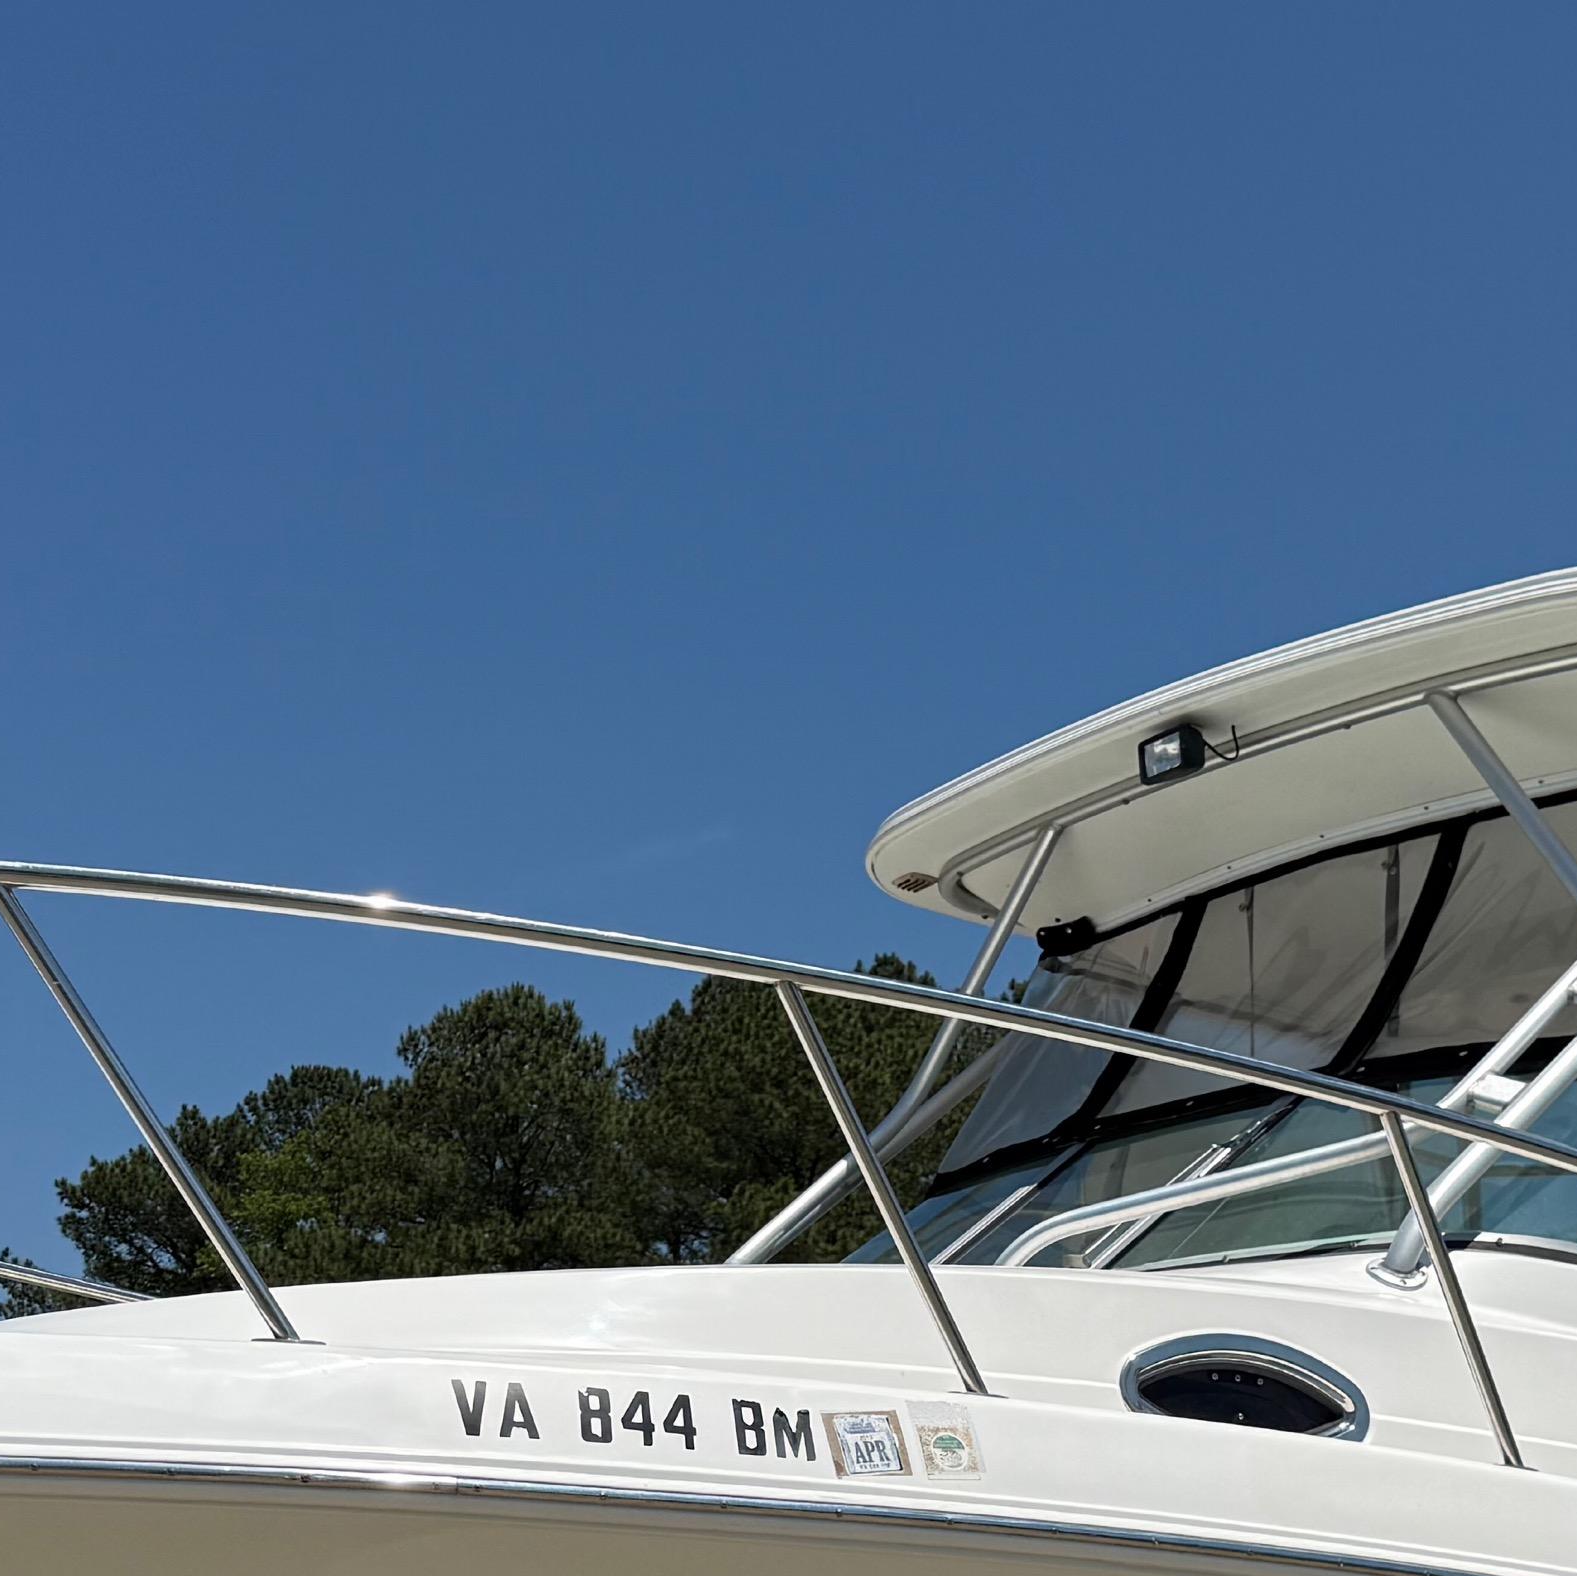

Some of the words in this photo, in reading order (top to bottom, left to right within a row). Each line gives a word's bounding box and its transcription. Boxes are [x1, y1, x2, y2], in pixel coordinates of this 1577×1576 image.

[450, 1378, 540, 1440] VA
[578, 1387, 697, 1451] 844
[731, 1398, 817, 1462] BM
[855, 1440, 891, 1464] APR
